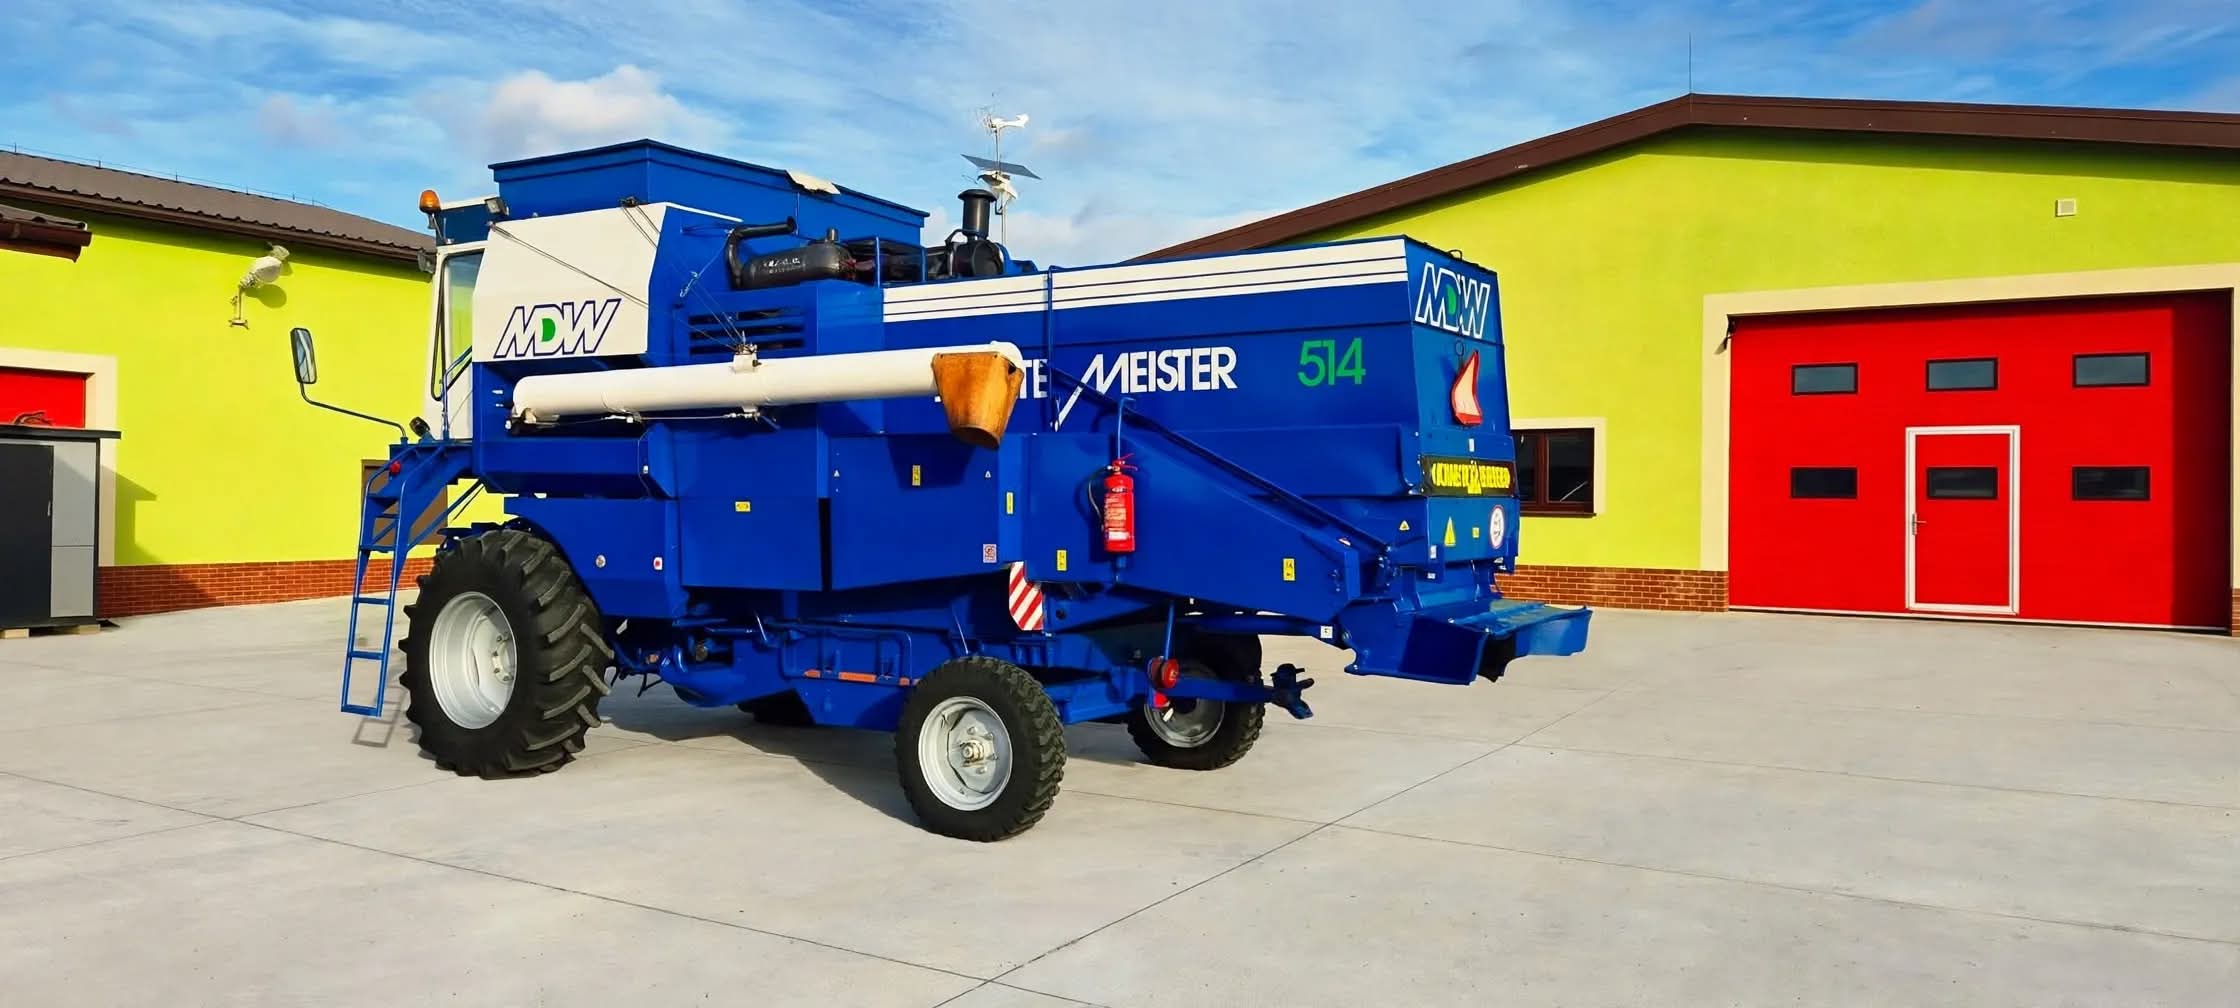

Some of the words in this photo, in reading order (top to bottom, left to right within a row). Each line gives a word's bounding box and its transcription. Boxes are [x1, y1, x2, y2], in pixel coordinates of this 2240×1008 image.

[493, 298, 622, 359] MDW
[1414, 261, 1491, 338] MDW
[1017, 358, 1049, 399] TE
[1053, 346, 1238, 430] MEISTER
[1298, 337, 1366, 386] 514
